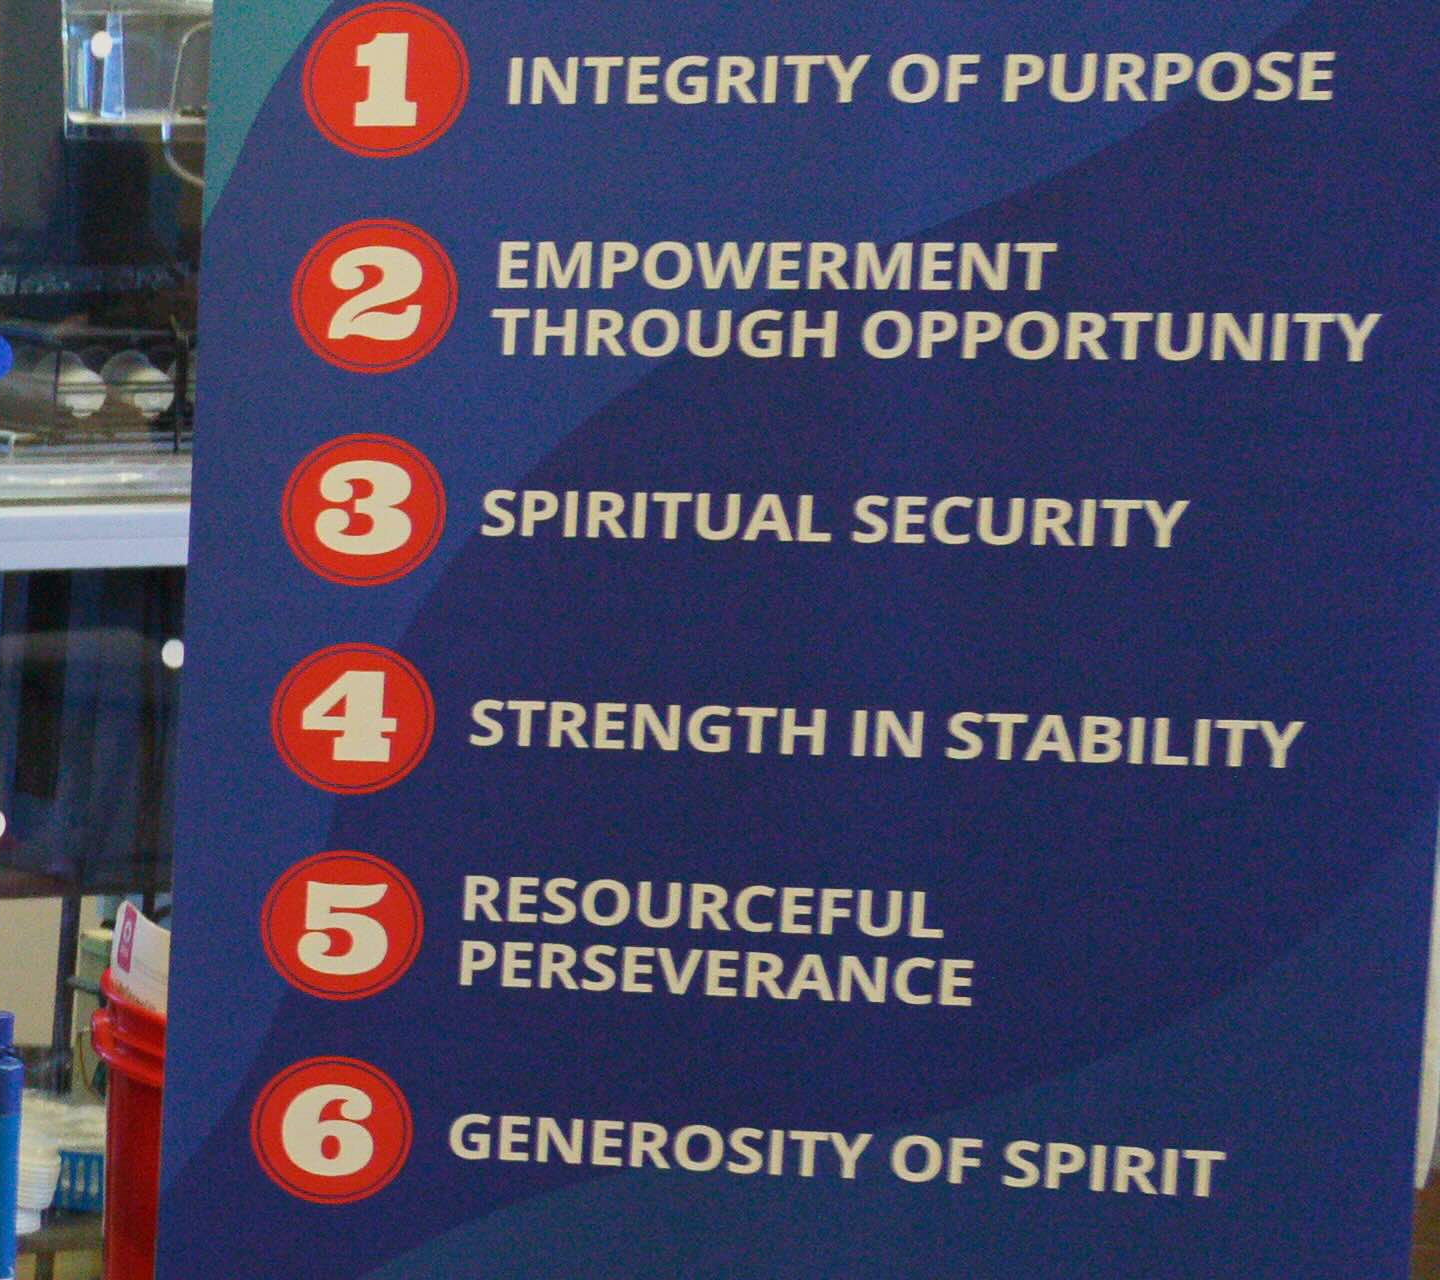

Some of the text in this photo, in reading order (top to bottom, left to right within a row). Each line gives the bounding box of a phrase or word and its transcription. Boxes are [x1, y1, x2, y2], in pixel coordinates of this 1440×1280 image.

[352, 32, 419, 128] 1
[506, 51, 1337, 106] INTEGRITY OF PURPOSE
[327, 244, 423, 340] 2
[496, 240, 1058, 292] EMPOWERMENT
[491, 306, 1382, 364] THROUGH OPPORTUNITY
[314, 460, 412, 556] 3
[481, 488, 1190, 549] SPIRITUAL SECURITY
[299, 668, 398, 763] 4
[468, 698, 1305, 770] STRENGTH IN STABILITY
[295, 881, 389, 974] 5
[462, 874, 945, 940] RESOURCEFUL
[459, 942, 975, 1007] PERSEVERANCE
[280, 1083, 378, 1177] 6
[448, 1112, 1225, 1198] GENEROSITY OF SPIRIT
